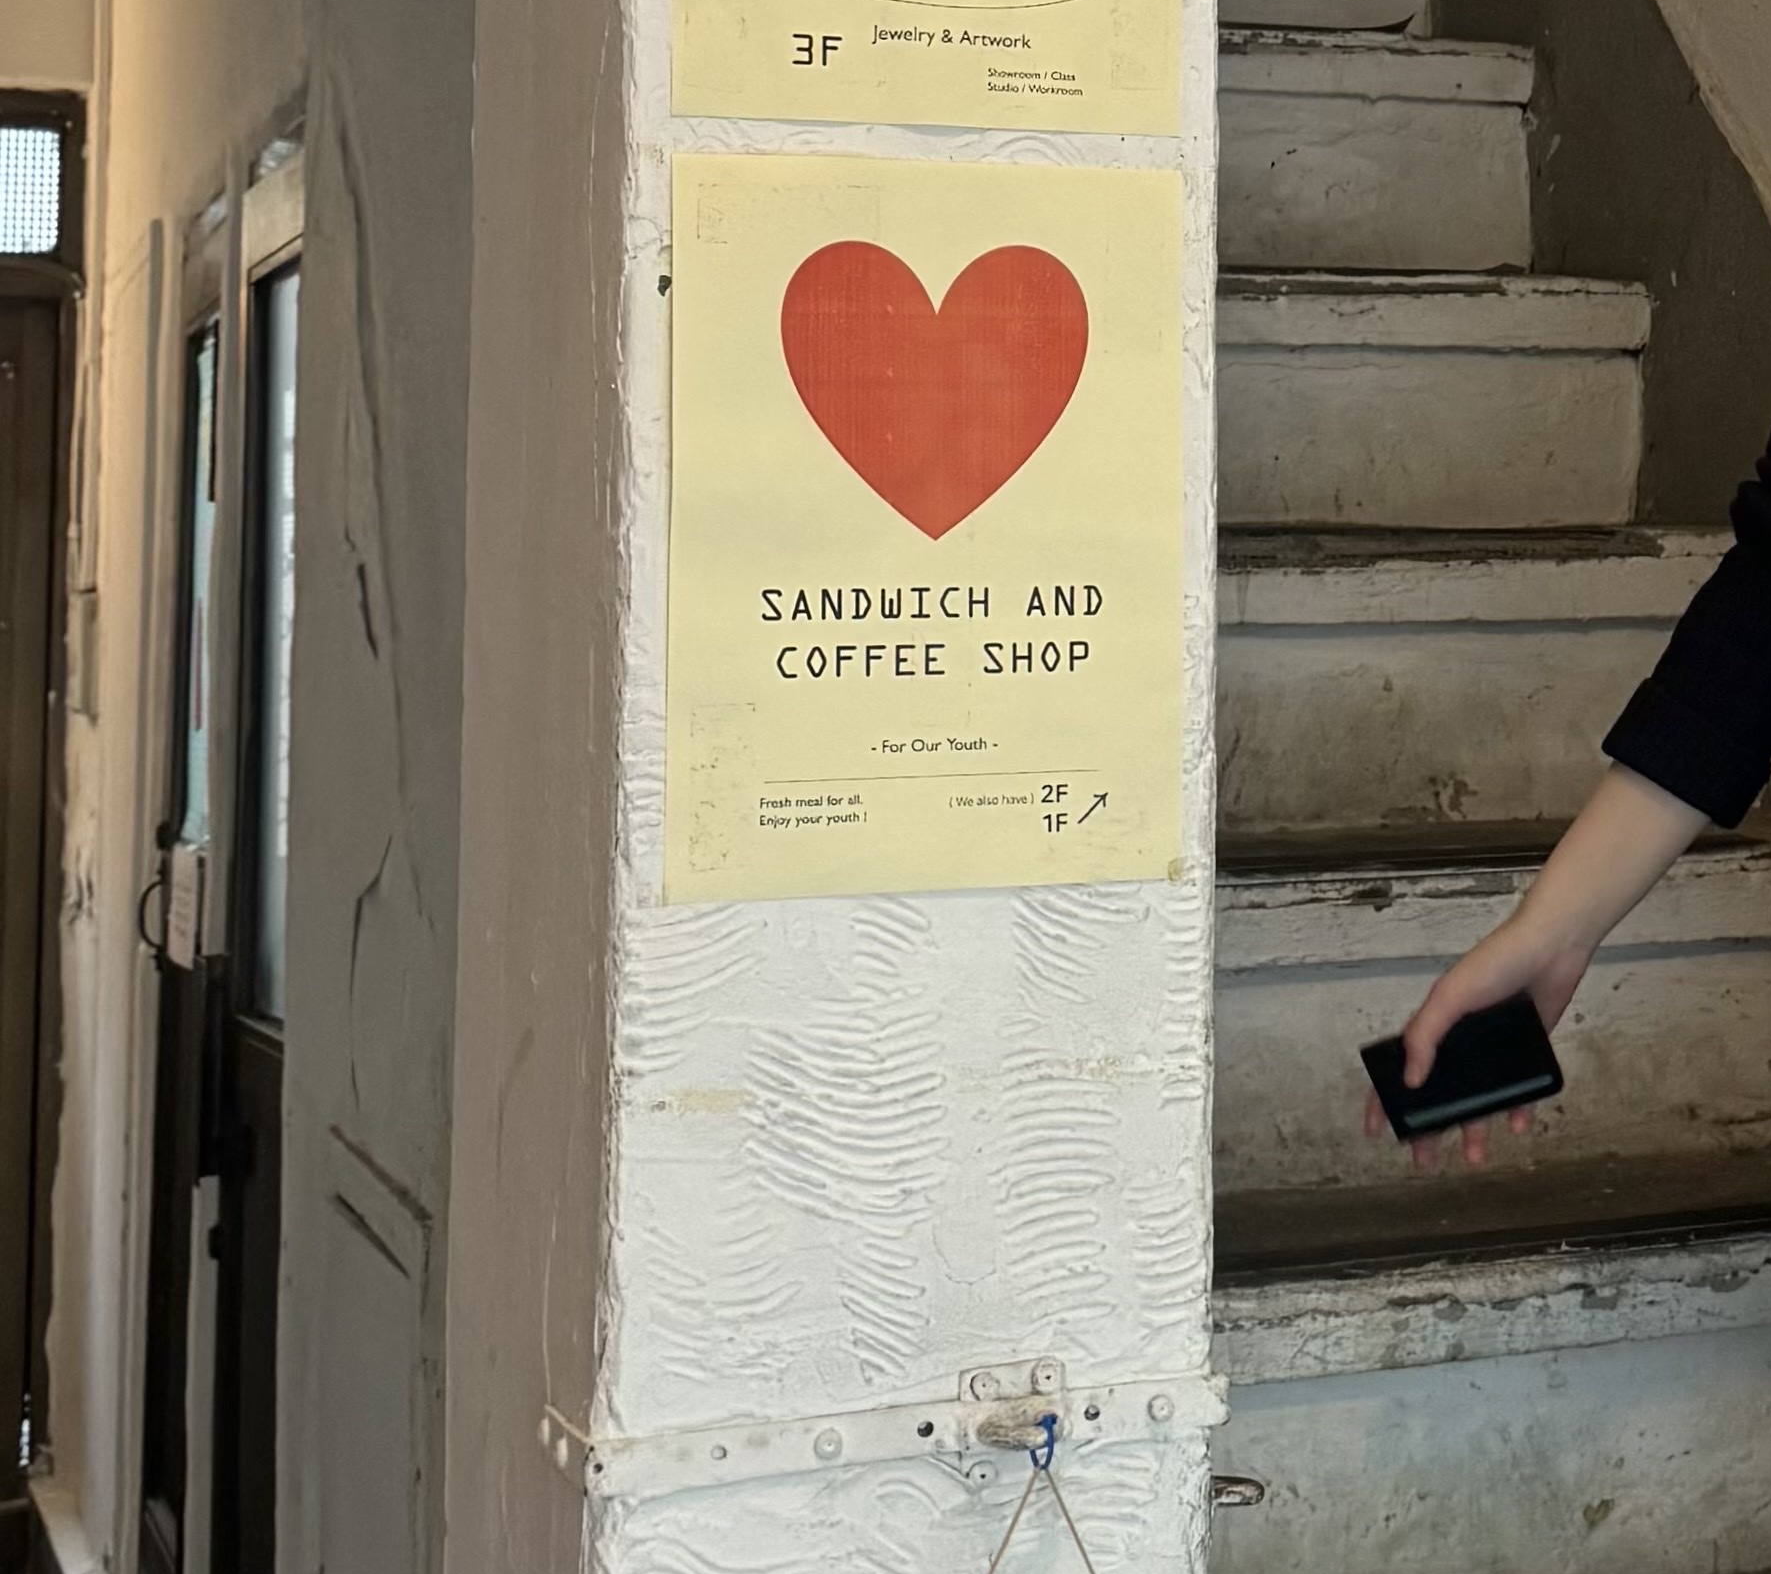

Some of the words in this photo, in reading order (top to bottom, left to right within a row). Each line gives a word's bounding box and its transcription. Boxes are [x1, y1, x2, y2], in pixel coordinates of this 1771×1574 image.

[871, 24, 936, 48] Jewelry
[941, 28, 954, 44] &
[959, 29, 1032, 49] Artwork
[791, 33, 843, 67] 3F
[987, 67, 1041, 80] Showroom
[987, 81, 1020, 94] Studio
[1028, 83, 1084, 97] Workroom
[761, 586, 989, 622] SANDWICH
[1026, 584, 1103, 617] AND
[776, 643, 946, 679] COFFEE
[983, 640, 1090, 674] SHOP
[882, 739, 907, 754] For
[910, 738, 943, 753] Our
[946, 737, 988, 751] Youth
[759, 796, 792, 809] Fresh
[795, 795, 824, 808] meal
[826, 795, 844, 806] for
[976, 795, 999, 807] also
[1040, 783, 1069, 804] 2F
[759, 814, 792, 829] Enjoy
[795, 815, 823, 829] your
[826, 812, 860, 827] youth
[1042, 812, 1069, 833] 1F
